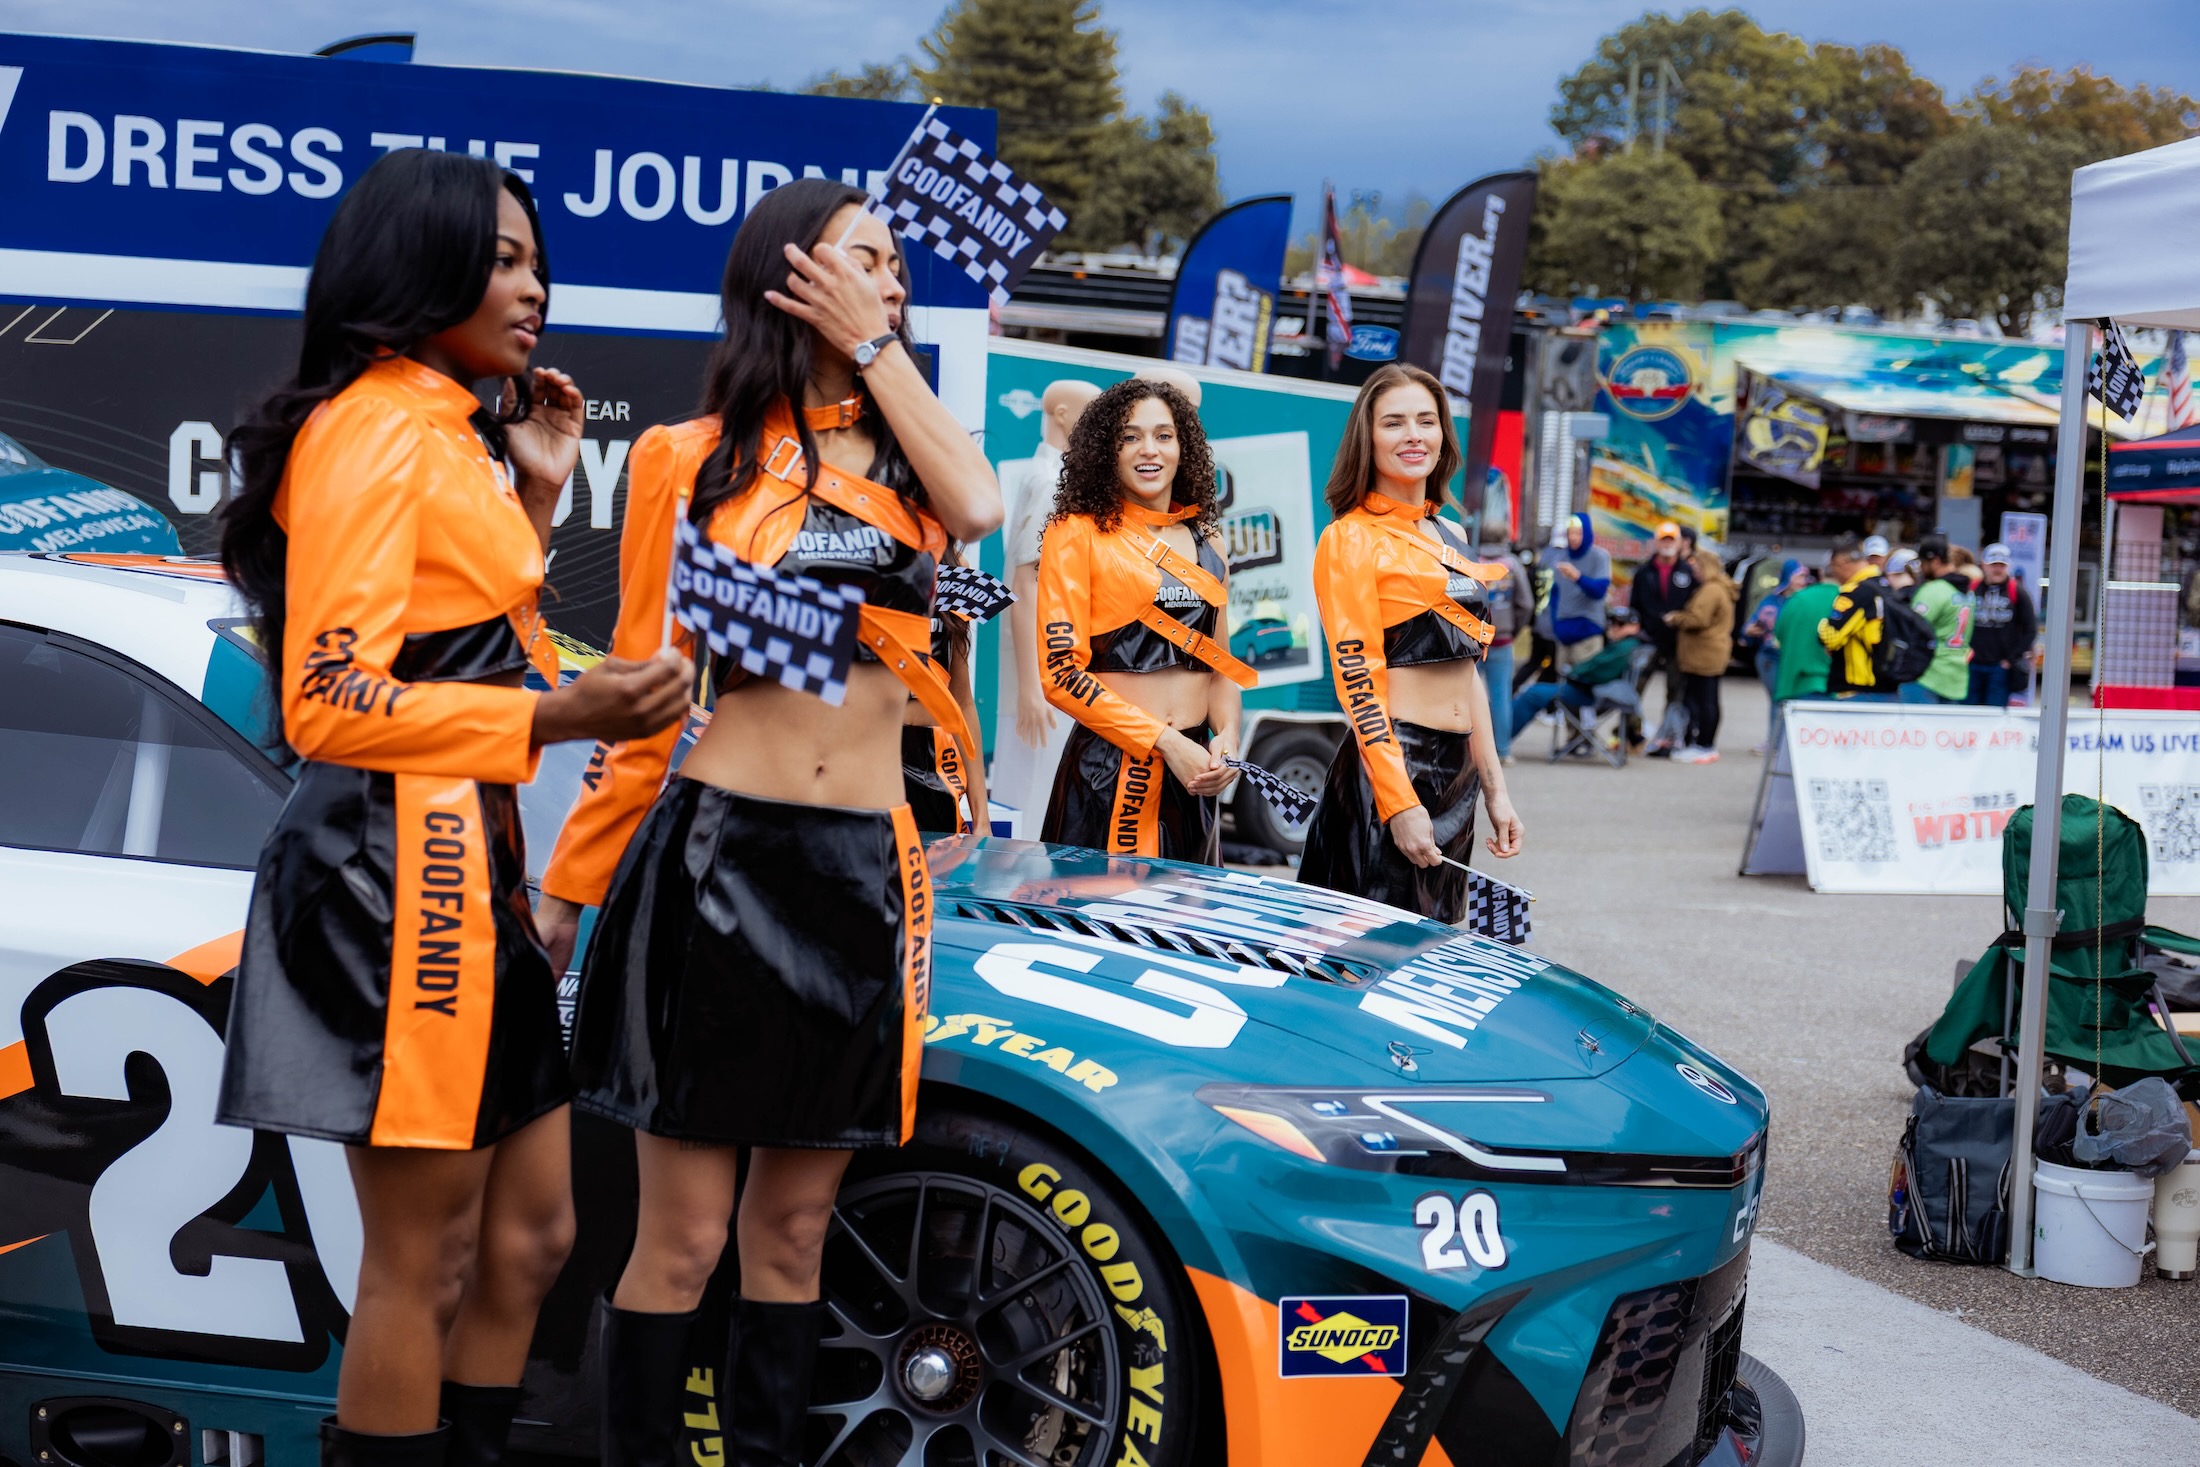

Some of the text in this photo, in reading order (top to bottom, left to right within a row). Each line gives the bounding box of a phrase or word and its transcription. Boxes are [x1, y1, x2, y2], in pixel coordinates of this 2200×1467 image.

[48, 110, 343, 198] DRESS
[897, 157, 1032, 259] COOFANDY
[1353, 333, 1392, 355] Ford
[2106, 358, 2132, 404] ANDY
[797, 548, 872, 560] MENSWEAR
[676, 560, 843, 647] COOFANDY
[1336, 639, 1391, 747] COOFANDY
[1800, 727, 1927, 748] DOWNLOAD
[1935, 729, 1979, 749] OUR
[1988, 730, 2024, 747] APP
[2067, 734, 2125, 752] REAM
[2131, 734, 2156, 753] US
[414, 811, 465, 1018] COOFANDY
[908, 845, 926, 1023] COOFANDY
[1491, 882, 1511, 940] OFANDY
[1358, 932, 1560, 1050] MENSWEA
[1416, 1192, 1506, 1271] 20
[1293, 1329, 1394, 1348] SUNOCO
[684, 1367, 725, 1467] GLE
